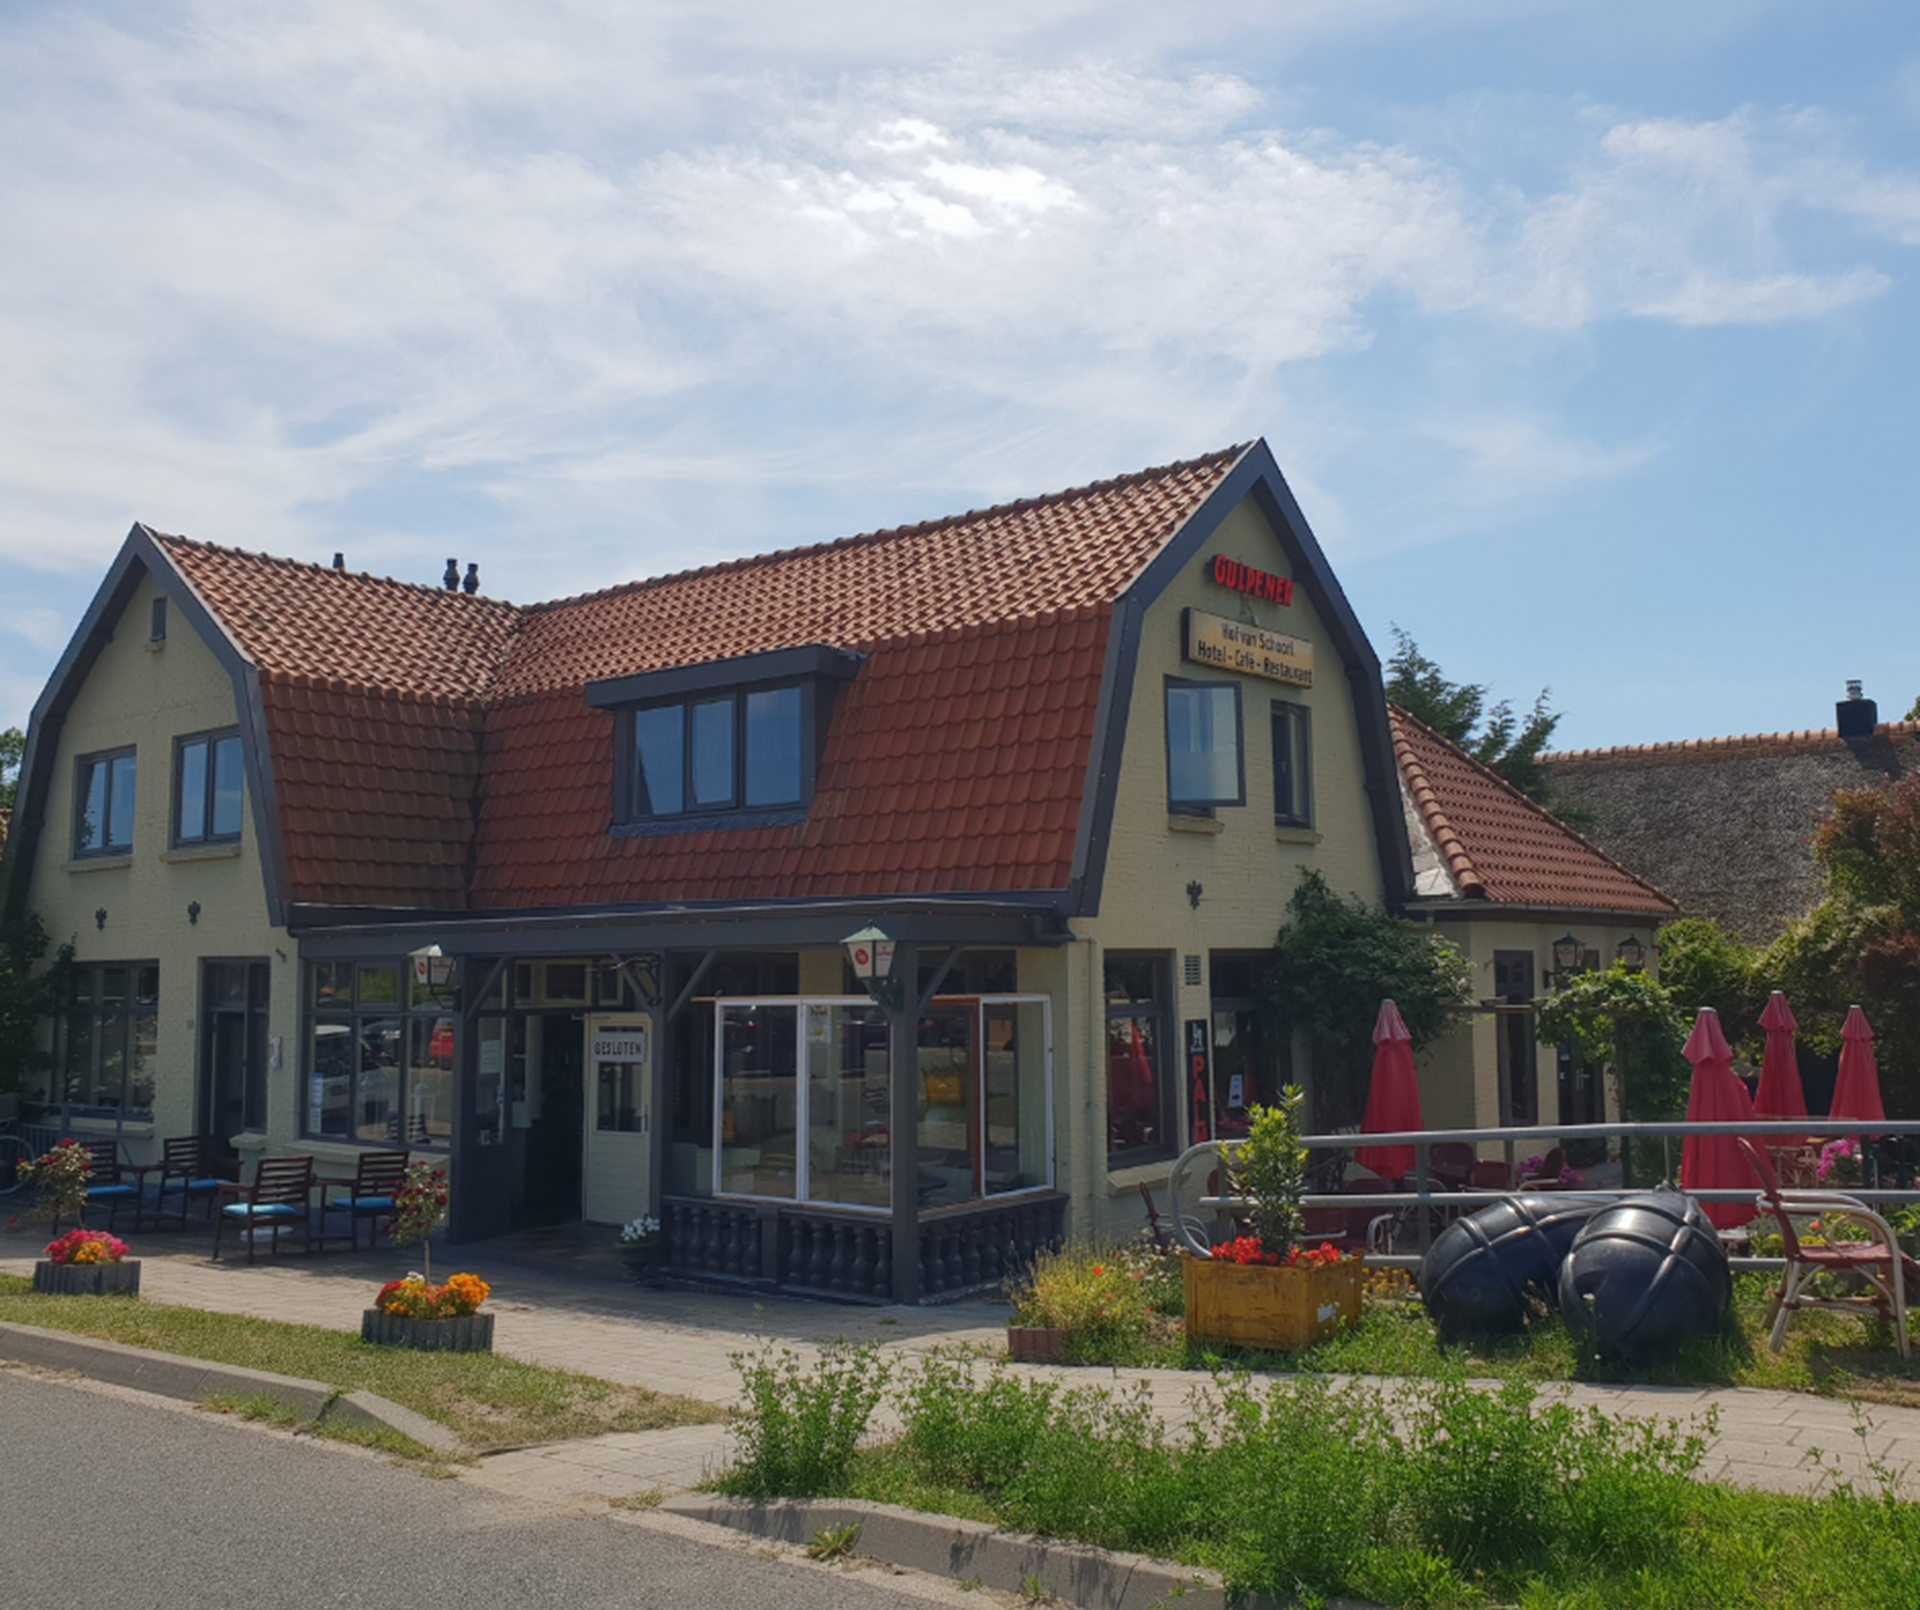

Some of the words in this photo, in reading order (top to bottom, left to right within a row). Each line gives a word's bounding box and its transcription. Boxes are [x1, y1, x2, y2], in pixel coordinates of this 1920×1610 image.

[1214, 554, 1293, 606] GULPENER
[1222, 623, 1239, 642] Hof
[1239, 631, 1257, 648] van
[1259, 633, 1295, 656] Schoorl
[1198, 640, 1227, 662] Hotel
[1264, 657, 1312, 683] Restaurant
[594, 1041, 642, 1055] GESLOTEN
